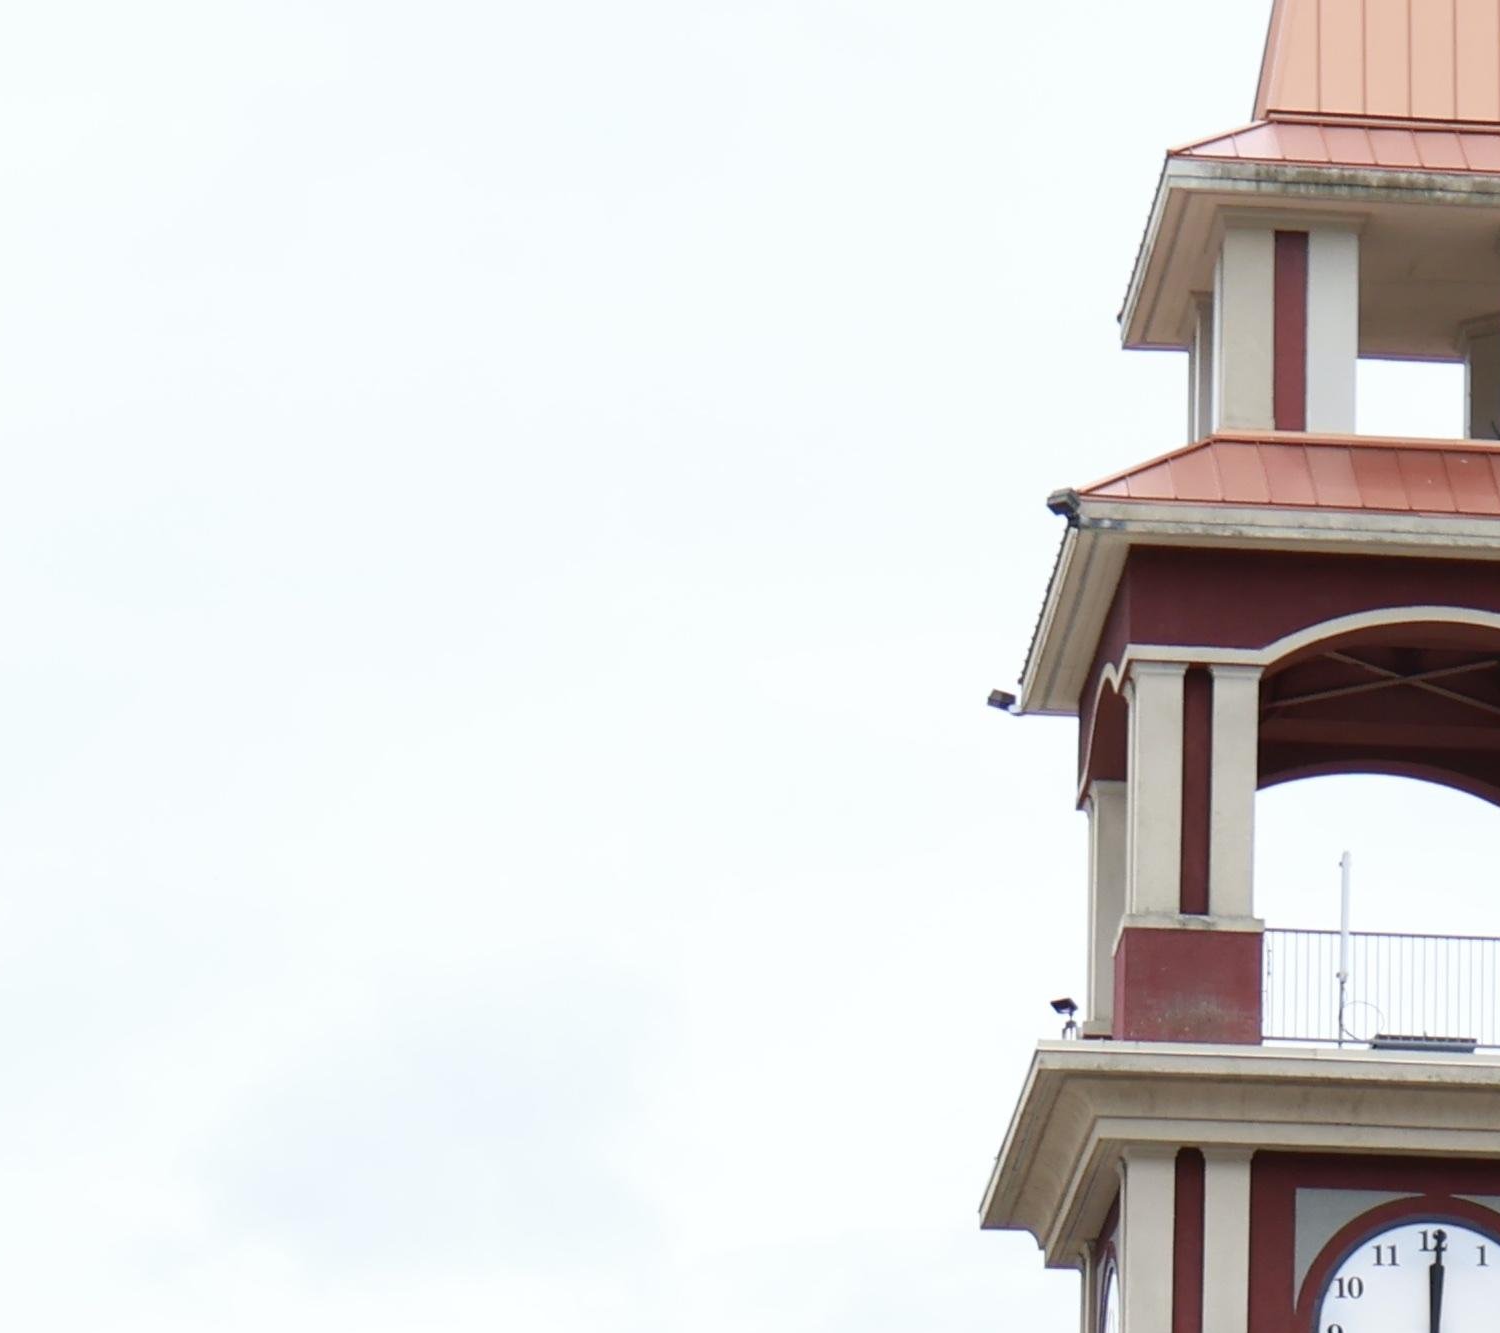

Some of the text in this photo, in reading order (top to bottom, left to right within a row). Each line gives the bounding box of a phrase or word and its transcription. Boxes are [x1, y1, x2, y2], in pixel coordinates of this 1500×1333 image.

[1372, 1245, 1400, 1266] 11
[1477, 1246, 1488, 1266] 1
[1334, 1277, 1363, 1298] 10
